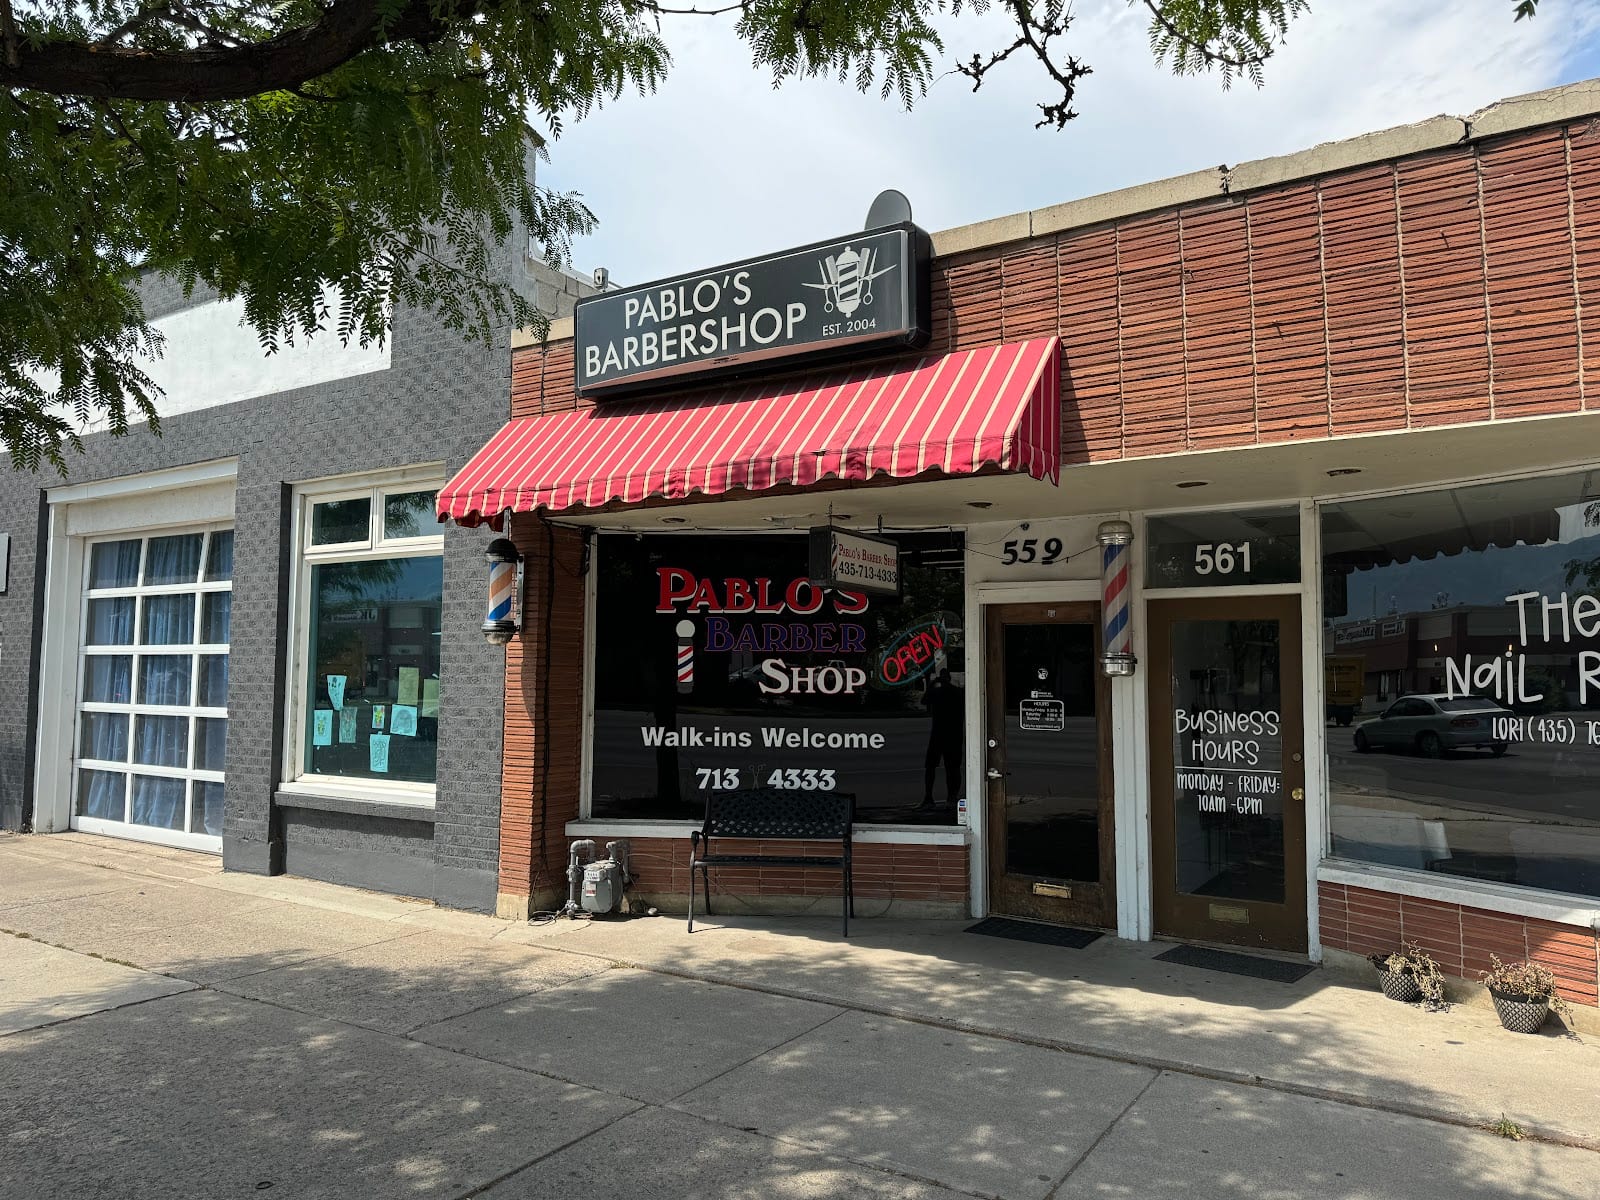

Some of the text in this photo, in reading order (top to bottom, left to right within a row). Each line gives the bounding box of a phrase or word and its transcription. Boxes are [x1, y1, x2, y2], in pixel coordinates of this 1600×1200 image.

[624, 271, 752, 330] PABLO'S
[585, 302, 808, 378] BARBERSHOP
[822, 318, 877, 336] EST. 2004
[838, 543, 861, 560] PABLO'S
[1001, 537, 1063, 566] 559
[1194, 541, 1251, 575] 561
[838, 560, 898, 584] 435-713-4333
[655, 567, 869, 615] PABLOS
[703, 616, 867, 653] BARBER
[882, 624, 944, 683] OPEN
[758, 658, 867, 694] SHOP
[641, 726, 886, 749] Walk-ins Welcome
[1527, 716, 1576, 744] (435)
[695, 767, 837, 791] 713 4333
